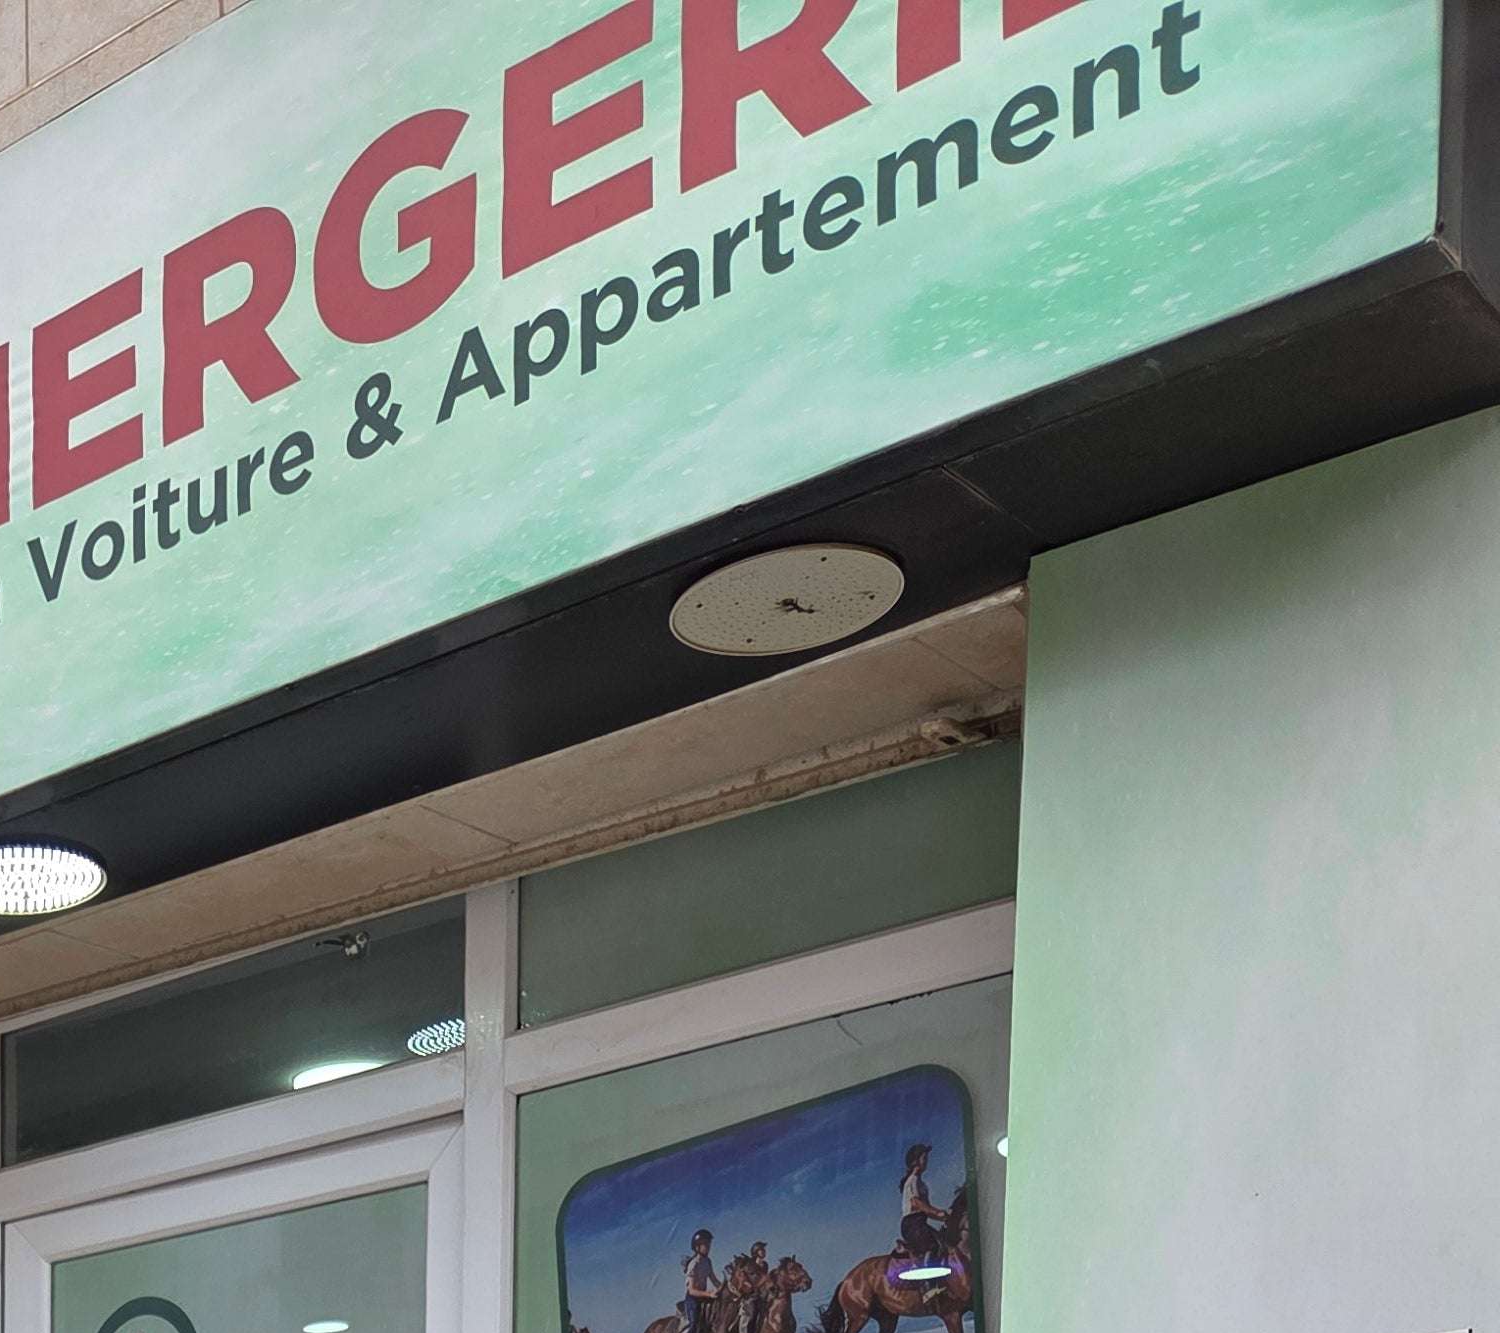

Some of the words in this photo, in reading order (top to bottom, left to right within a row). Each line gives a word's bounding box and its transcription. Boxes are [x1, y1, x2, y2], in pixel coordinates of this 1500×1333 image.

[27, 425, 314, 602] Voiture
[346, 375, 404, 462] &
[435, 0, 1201, 421] Appartement
